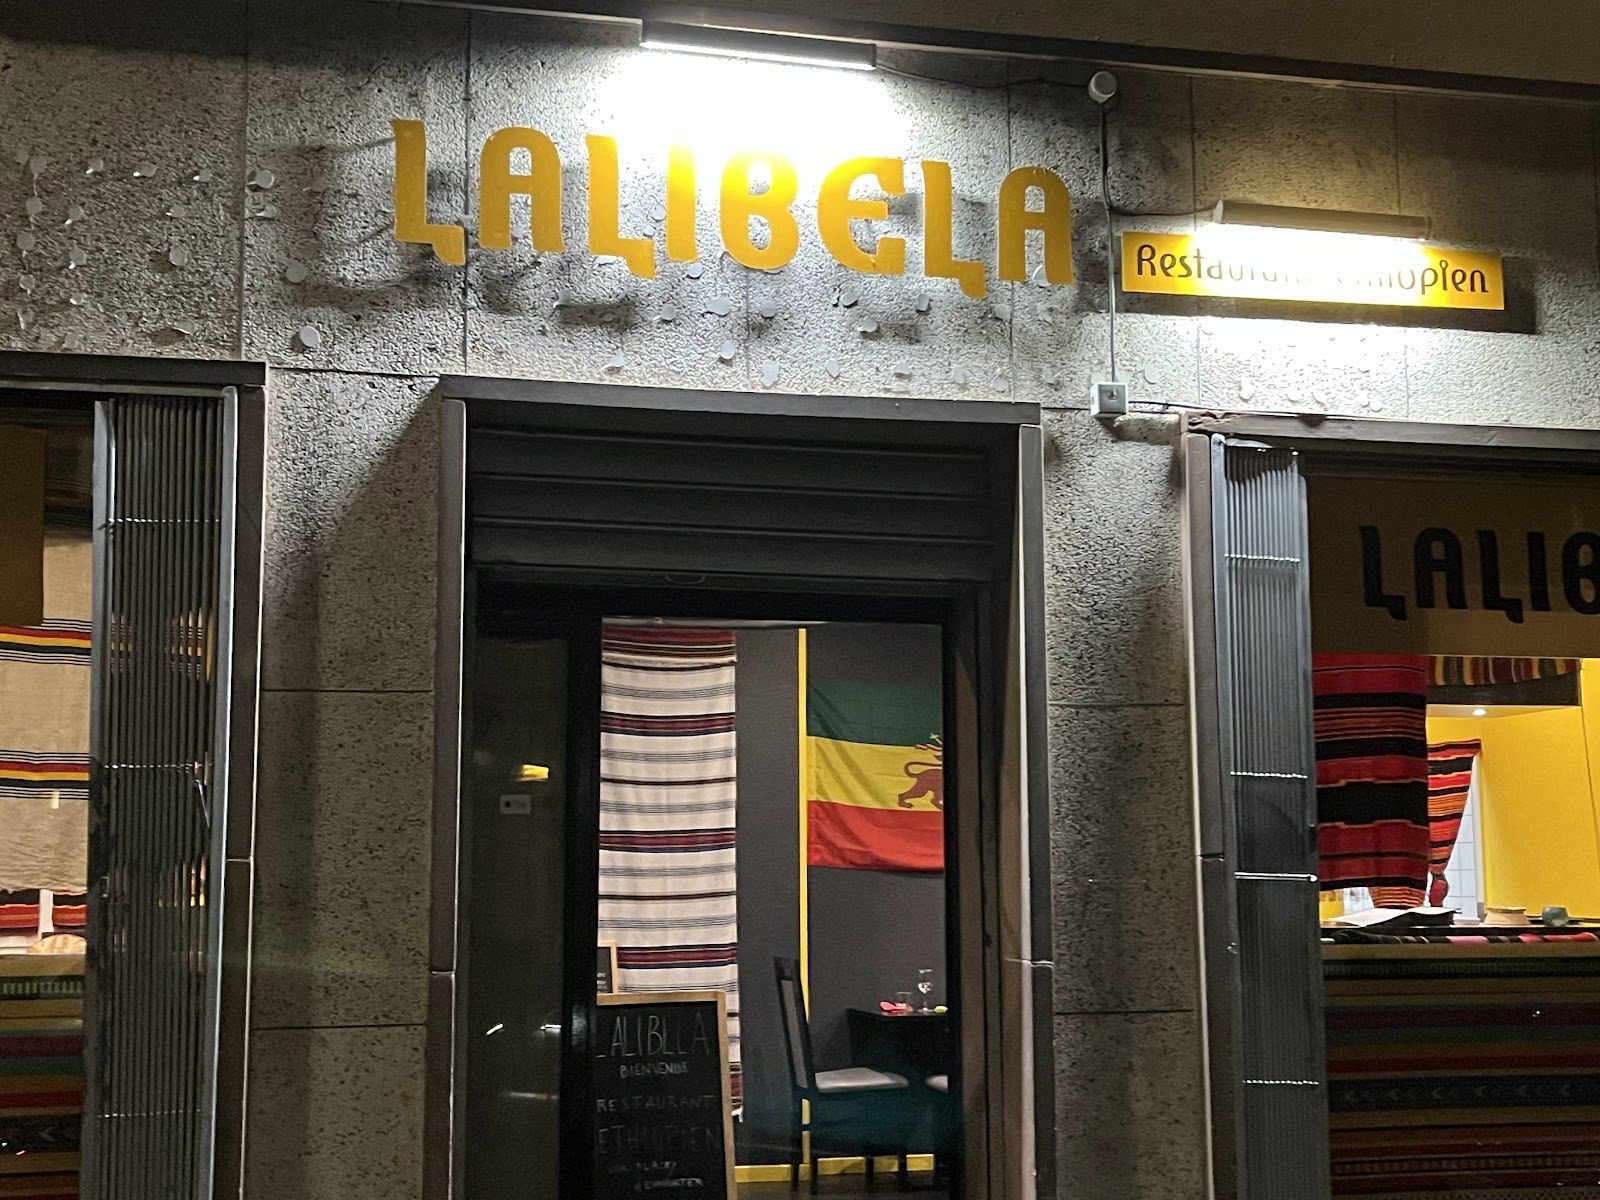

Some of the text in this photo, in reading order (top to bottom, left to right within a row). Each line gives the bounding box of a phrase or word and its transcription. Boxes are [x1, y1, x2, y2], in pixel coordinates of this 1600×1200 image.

[389, 118, 1077, 299] LALIBELA
[1136, 244, 1489, 296] Restau opien
[1359, 525, 1600, 623] LALIB
[596, 1011, 710, 1057] ALIBLA
